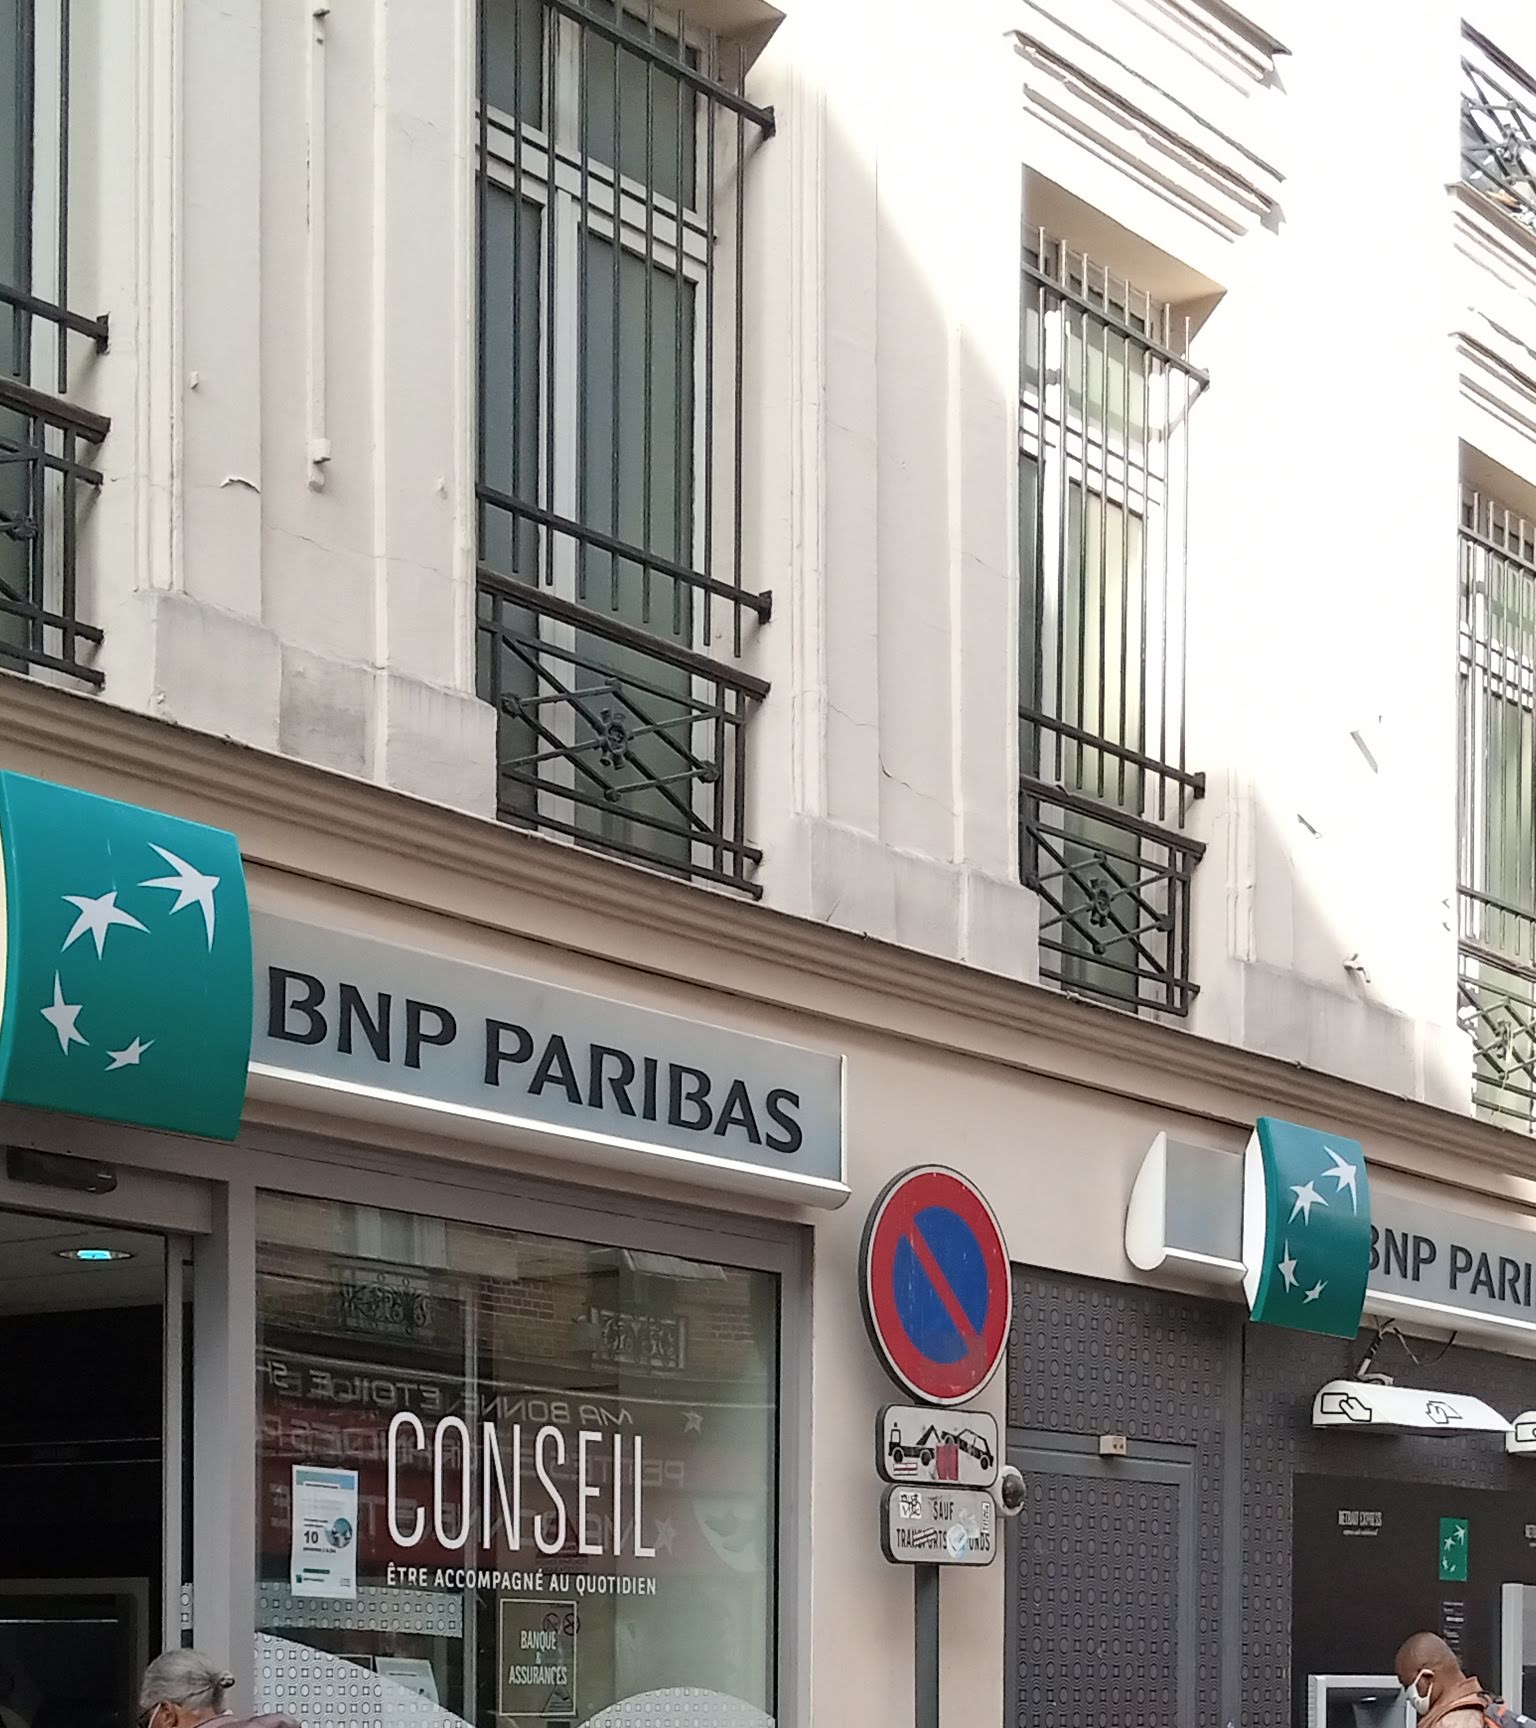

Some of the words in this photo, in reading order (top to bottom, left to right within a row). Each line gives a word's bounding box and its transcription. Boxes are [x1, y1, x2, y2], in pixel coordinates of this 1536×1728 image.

[267, 966, 457, 1069] BNP
[484, 1018, 804, 1154] PARIBAS
[387, 1412, 656, 1557] CONSEIL
[933, 1501, 954, 1521] SAUF
[304, 1531, 319, 1544] 10
[387, 1562, 428, 1587] ÊTRE
[434, 1568, 543, 1592] ACCOMPAGNÉ
[549, 1574, 570, 1592] AU
[576, 1575, 656, 1596] QUOTIDIEN
[520, 1630, 557, 1651] BANQUE
[508, 1665, 567, 1685] ASSURANCES
